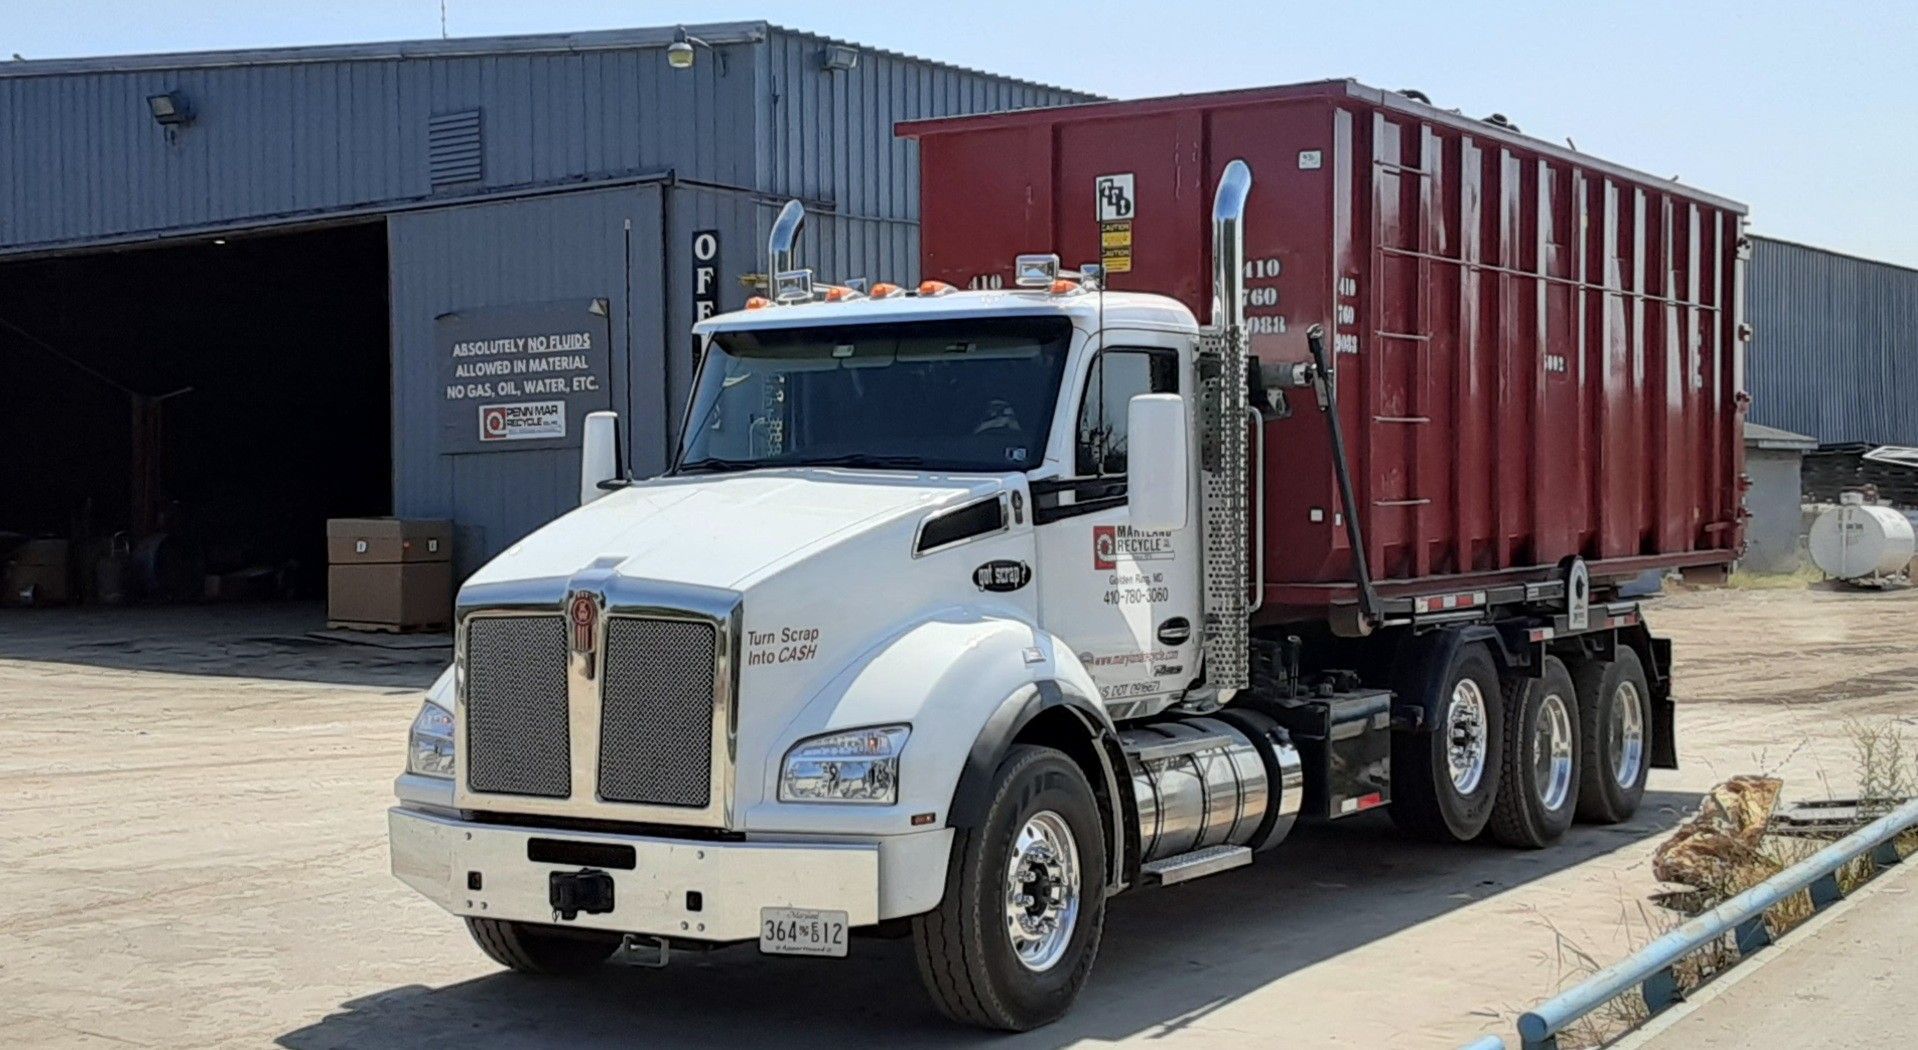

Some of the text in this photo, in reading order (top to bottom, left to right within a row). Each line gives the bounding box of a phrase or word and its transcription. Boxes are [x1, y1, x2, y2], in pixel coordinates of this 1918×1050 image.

[452, 333, 591, 357] ABSOLUTELY NO FLUIDS
[455, 355, 589, 377] ALLOWED IN MATERIAL
[446, 376, 599, 399] NO GAS, OIL, WATER, ETC.
[506, 405, 558, 417] PENN MAR
[506, 417, 542, 427] RECYCLE
[1117, 538, 1161, 551] RECYCLE
[978, 564, 993, 592] got
[748, 627, 819, 646] Turn Scrap
[748, 644, 818, 666] Into CASH
[765, 919, 797, 942] 364
